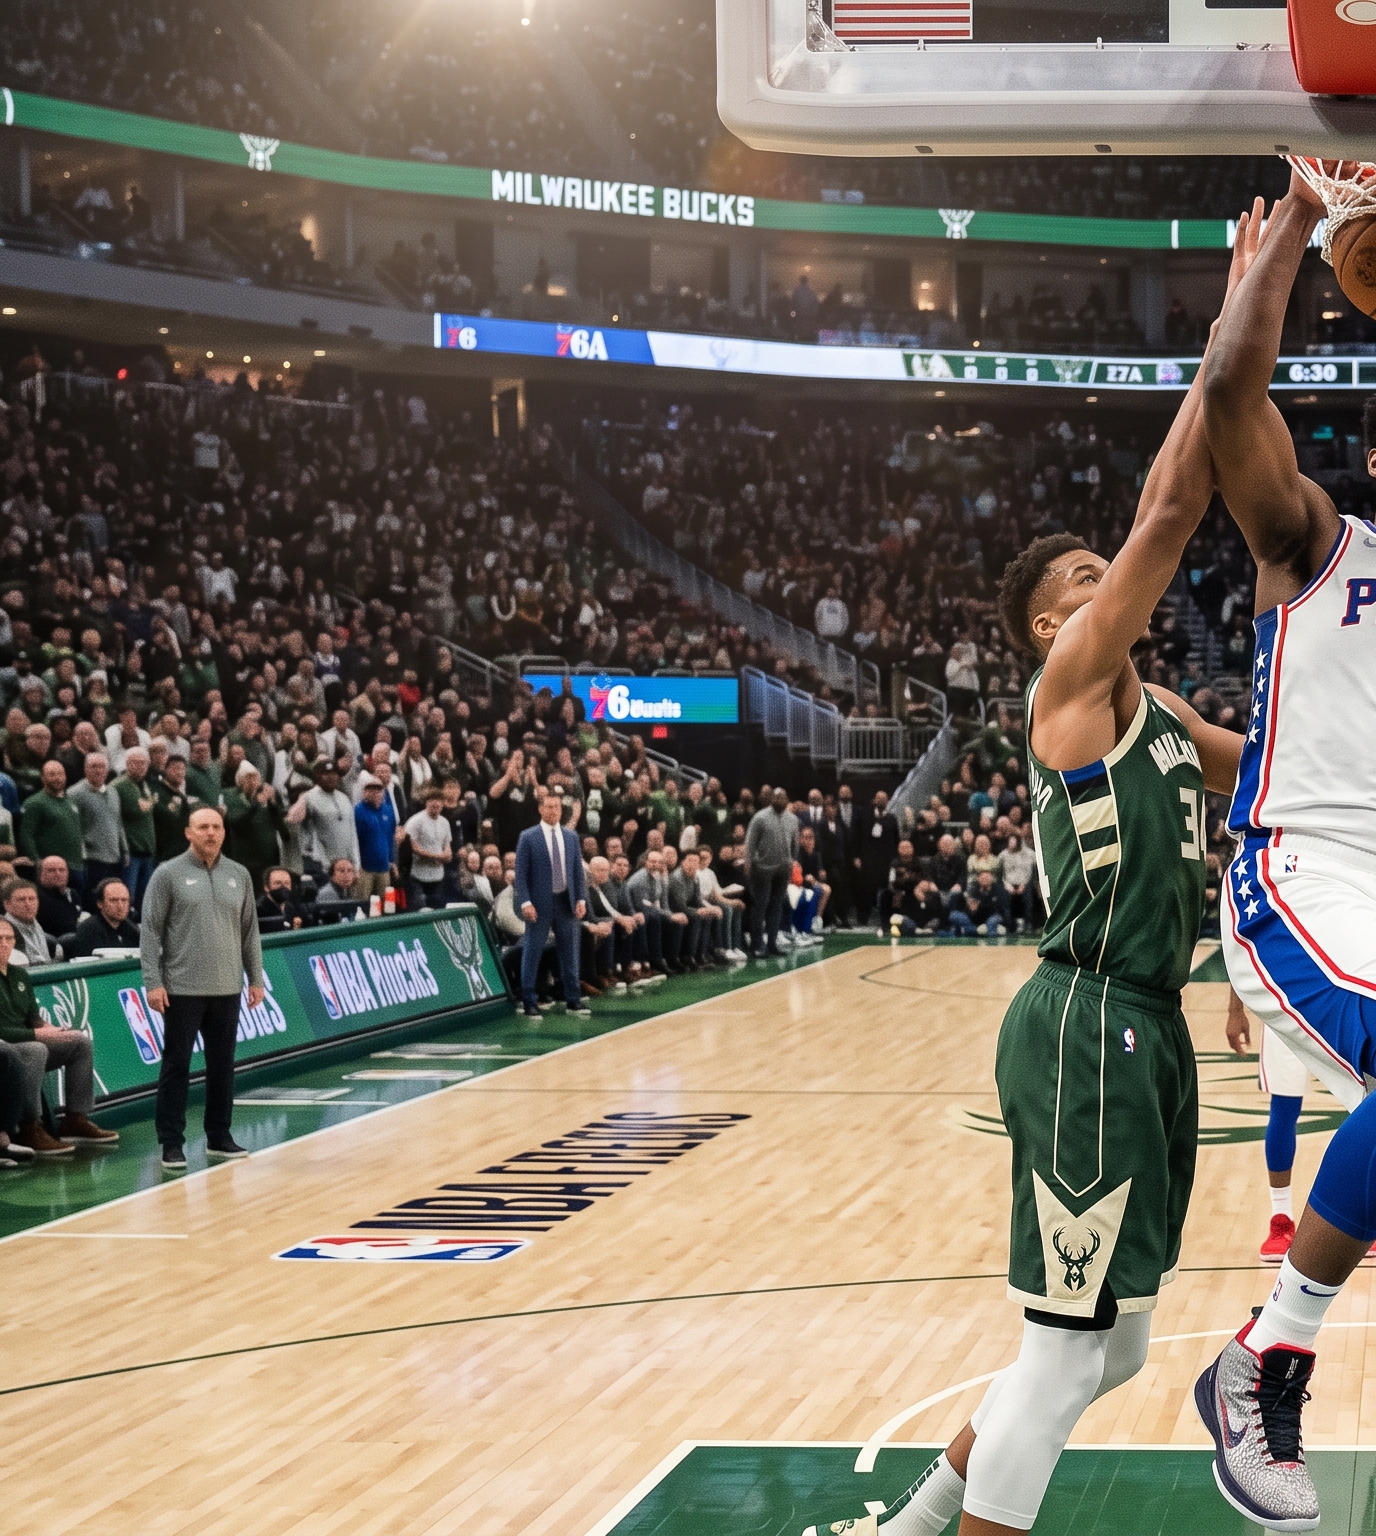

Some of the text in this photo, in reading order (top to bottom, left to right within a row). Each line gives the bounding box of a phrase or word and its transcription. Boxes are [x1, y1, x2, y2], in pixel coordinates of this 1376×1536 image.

[491, 169, 755, 227] MILWAUKEE BUCKS
[447, 326, 477, 350] 76
[590, 684, 630, 720] 76
[325, 949, 379, 1016] NBA
[348, 1181, 634, 1232] NBA
